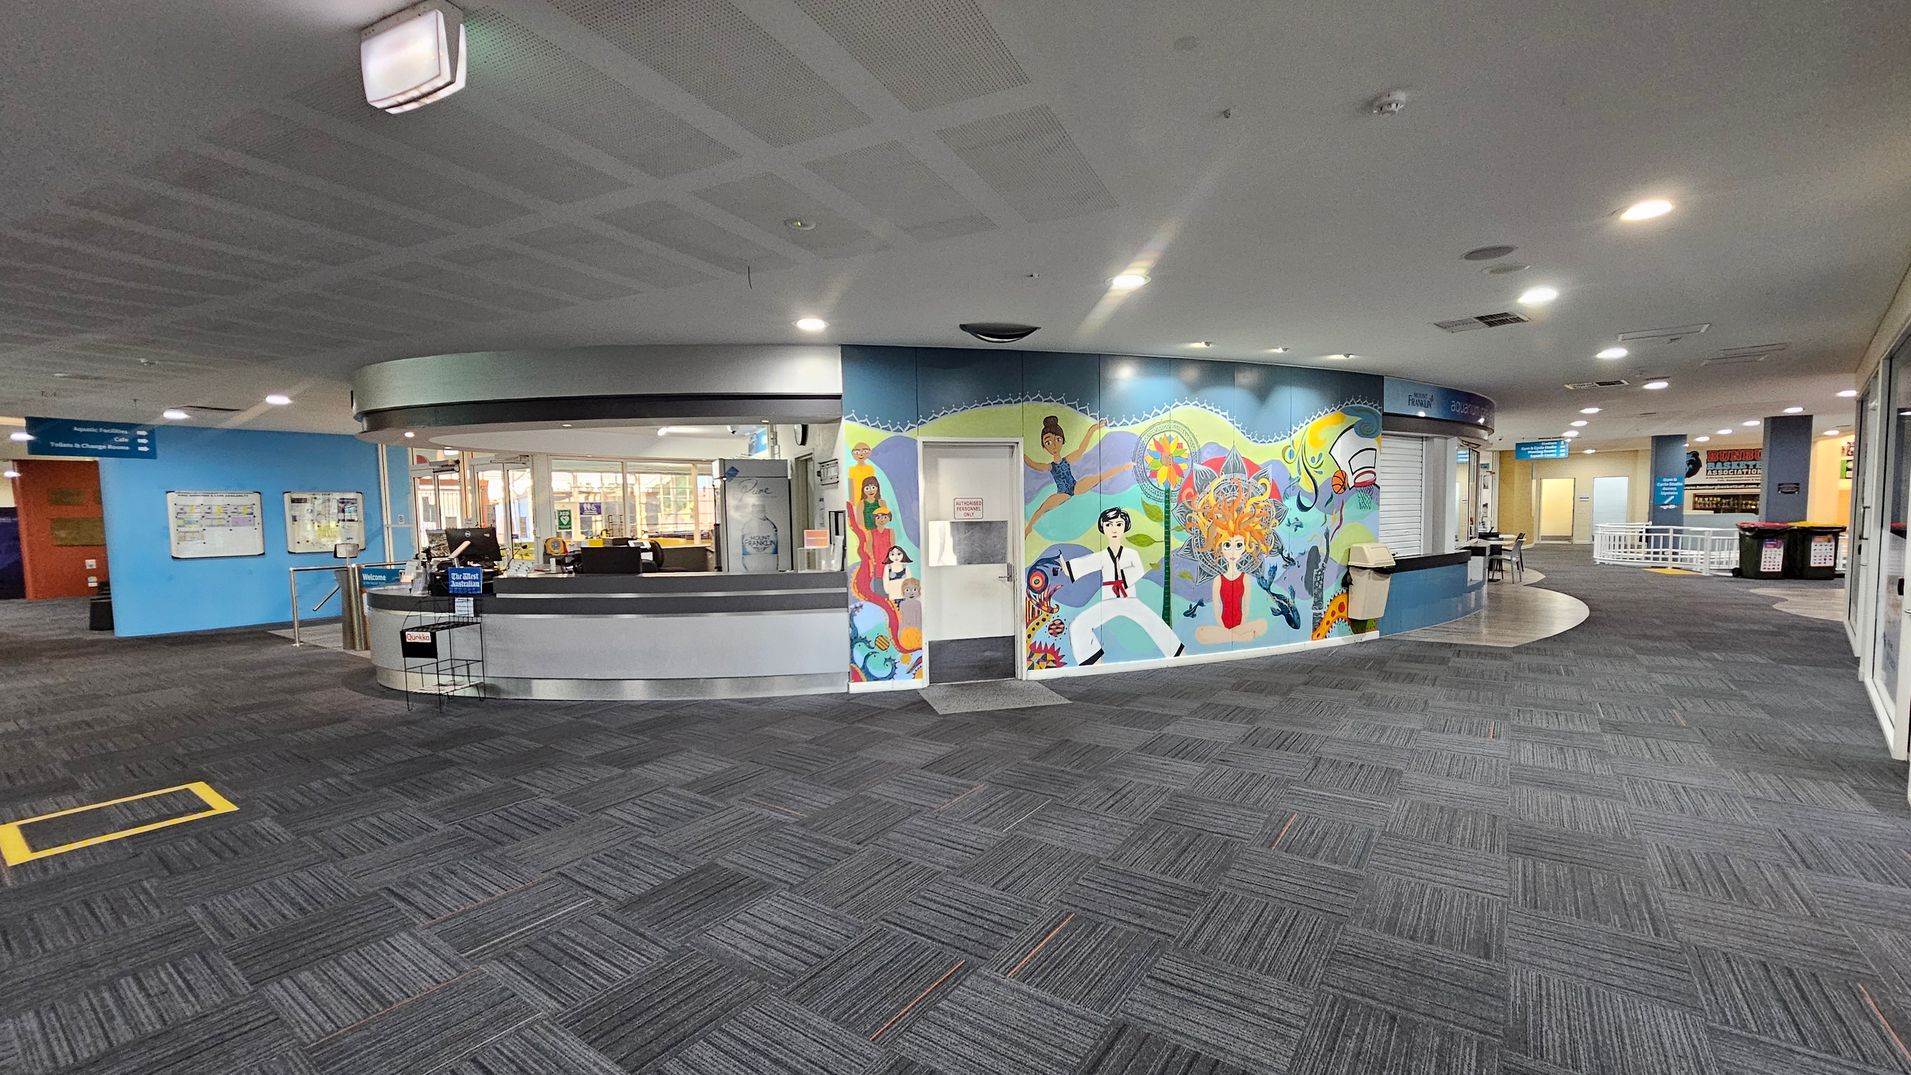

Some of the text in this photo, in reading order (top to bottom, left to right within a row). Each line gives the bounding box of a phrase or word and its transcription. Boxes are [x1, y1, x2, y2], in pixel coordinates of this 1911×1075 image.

[1408, 395, 1432, 408] FRANKLIN
[362, 573, 386, 581] Welcome
[451, 572, 479, 580] The West
[450, 580, 480, 588] Australian
